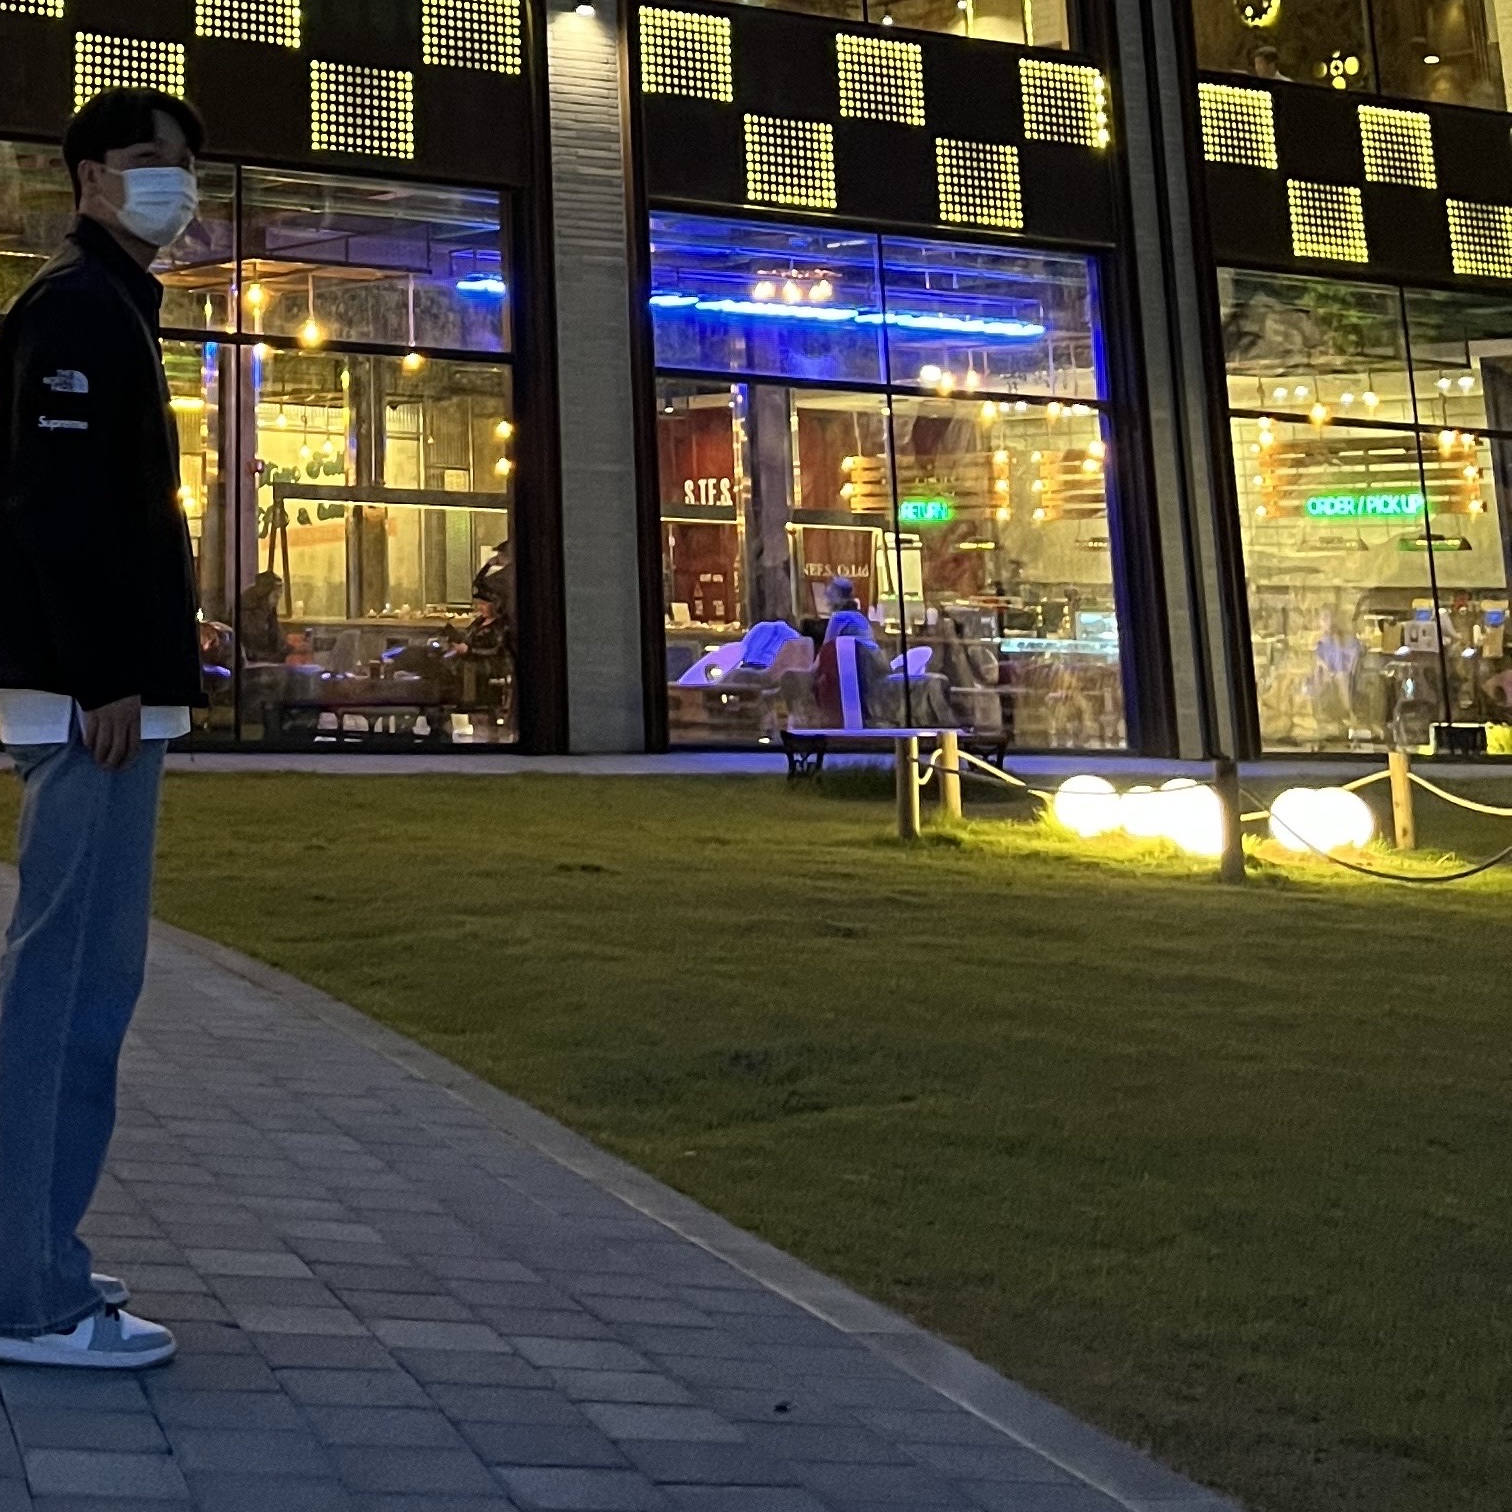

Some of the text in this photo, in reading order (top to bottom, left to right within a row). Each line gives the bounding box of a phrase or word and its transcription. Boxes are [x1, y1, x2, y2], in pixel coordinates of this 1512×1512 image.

[899, 500, 948, 521] RETURN
[1306, 495, 1355, 516] ORDER
[1366, 494, 1400, 515] PICK
